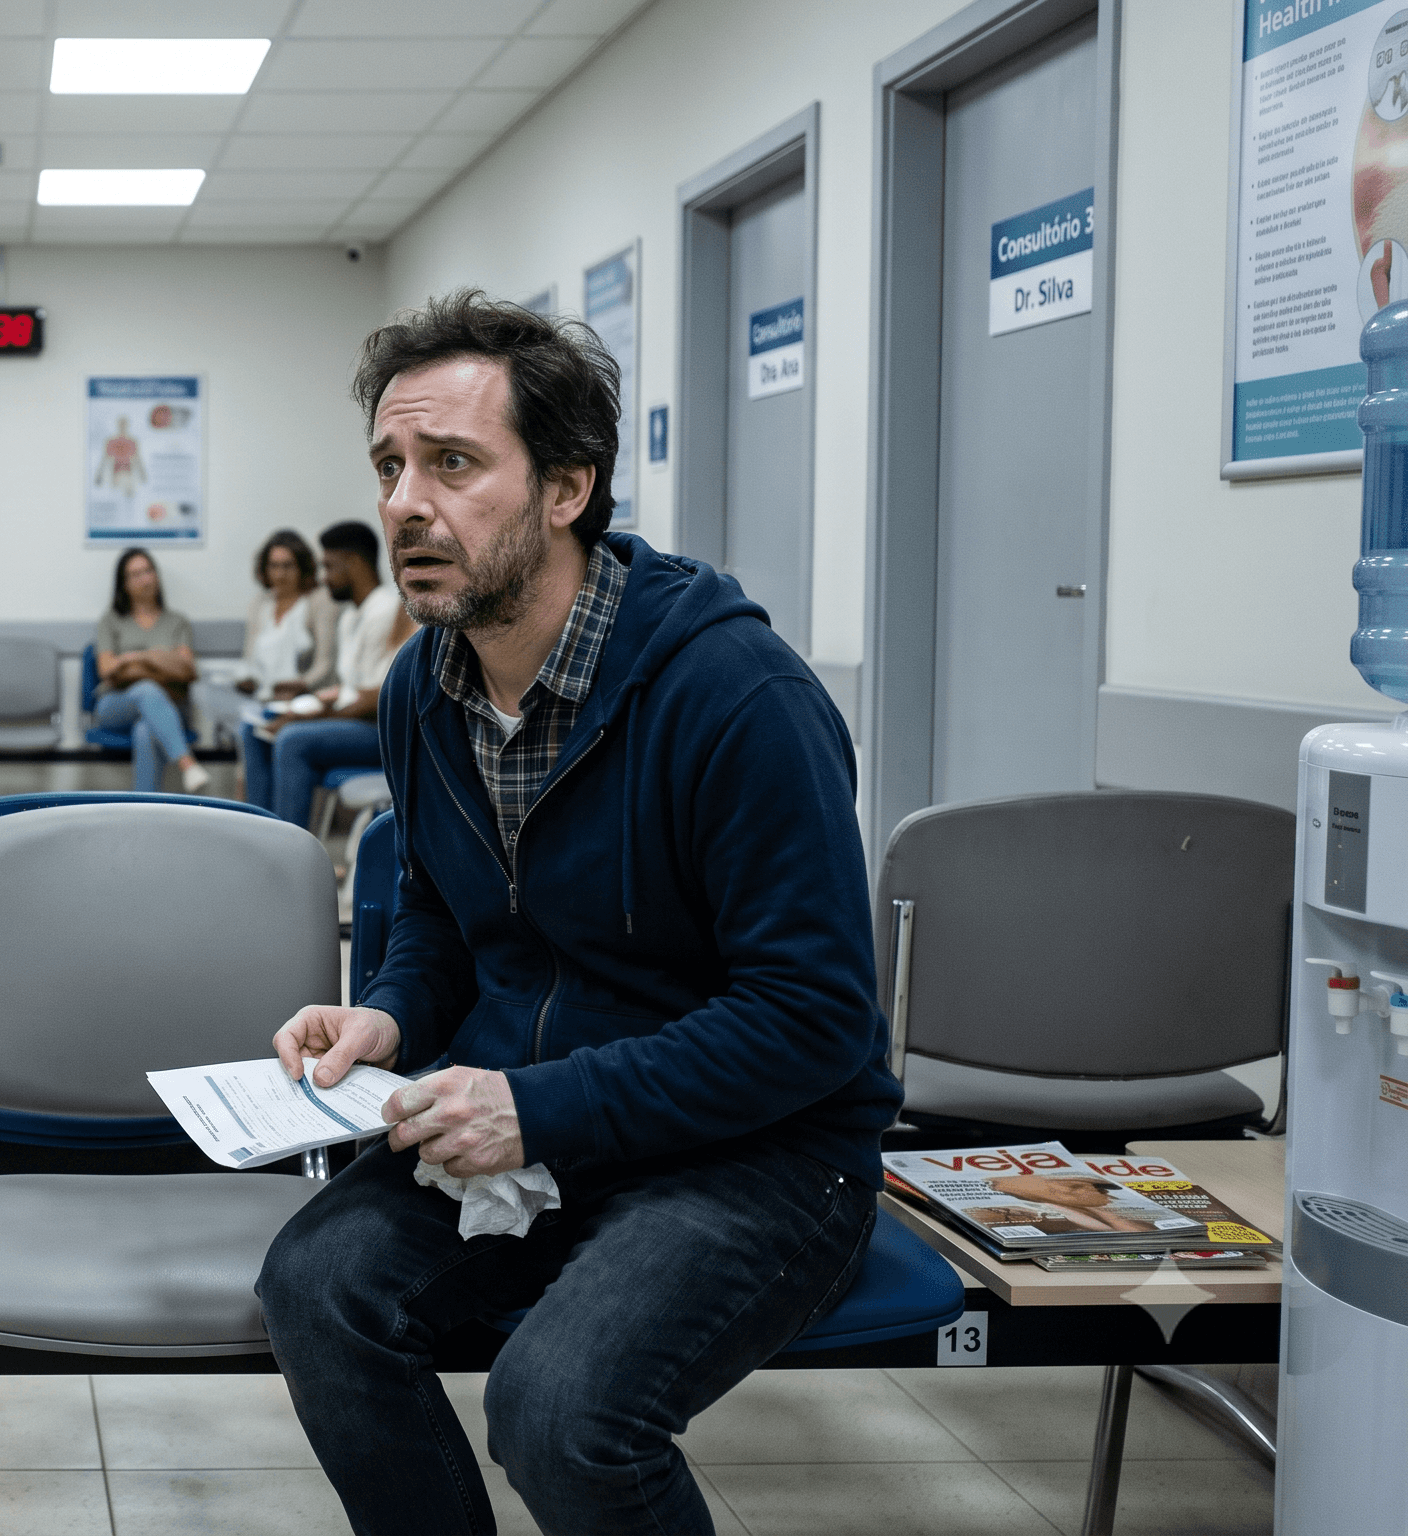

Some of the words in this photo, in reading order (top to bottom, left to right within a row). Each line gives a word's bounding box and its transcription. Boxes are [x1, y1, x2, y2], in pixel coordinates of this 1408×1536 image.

[1259, 0, 1322, 38] Health
[997, 211, 1081, 263] Consultório
[1084, 205, 1094, 235] 3
[1015, 287, 1034, 313] Dr.
[1039, 276, 1074, 307] Silva
[920, 1149, 1072, 1176] veja
[945, 1326, 981, 1353] 13
